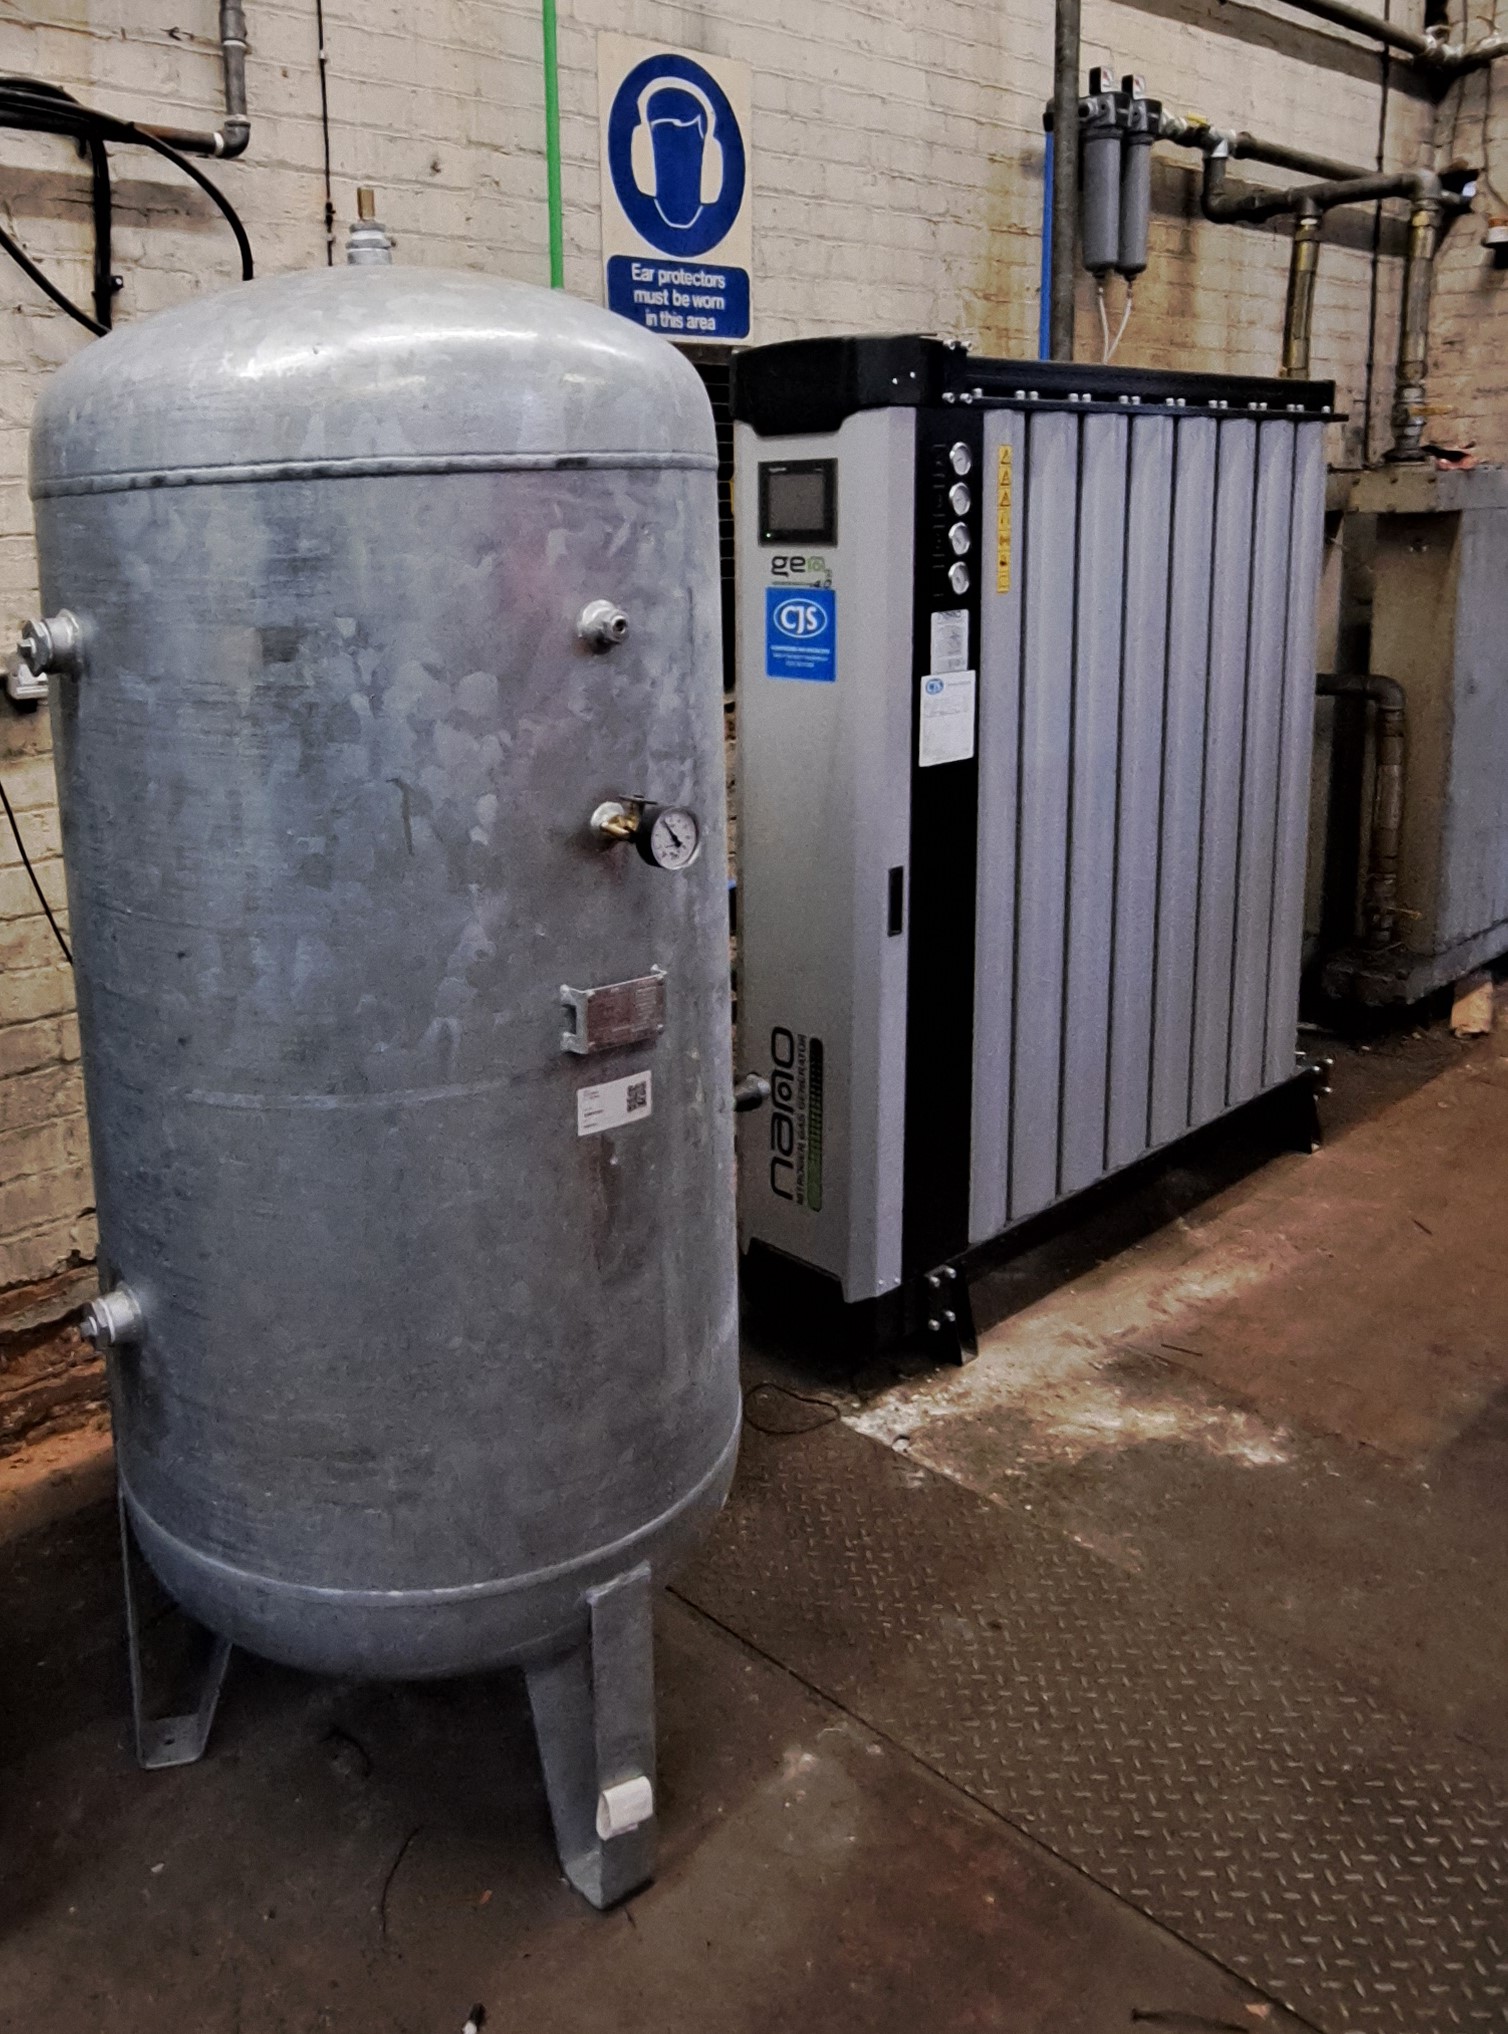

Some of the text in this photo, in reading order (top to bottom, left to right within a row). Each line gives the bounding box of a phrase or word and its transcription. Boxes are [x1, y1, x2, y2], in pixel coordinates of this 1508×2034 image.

[631, 263, 726, 290] Ear protectors
[633, 289, 725, 310] must be worn
[645, 308, 716, 331] in this area
[781, 605, 818, 634] CJS
[770, 1026, 794, 1201] nano
[798, 1114, 807, 1141] GAS
